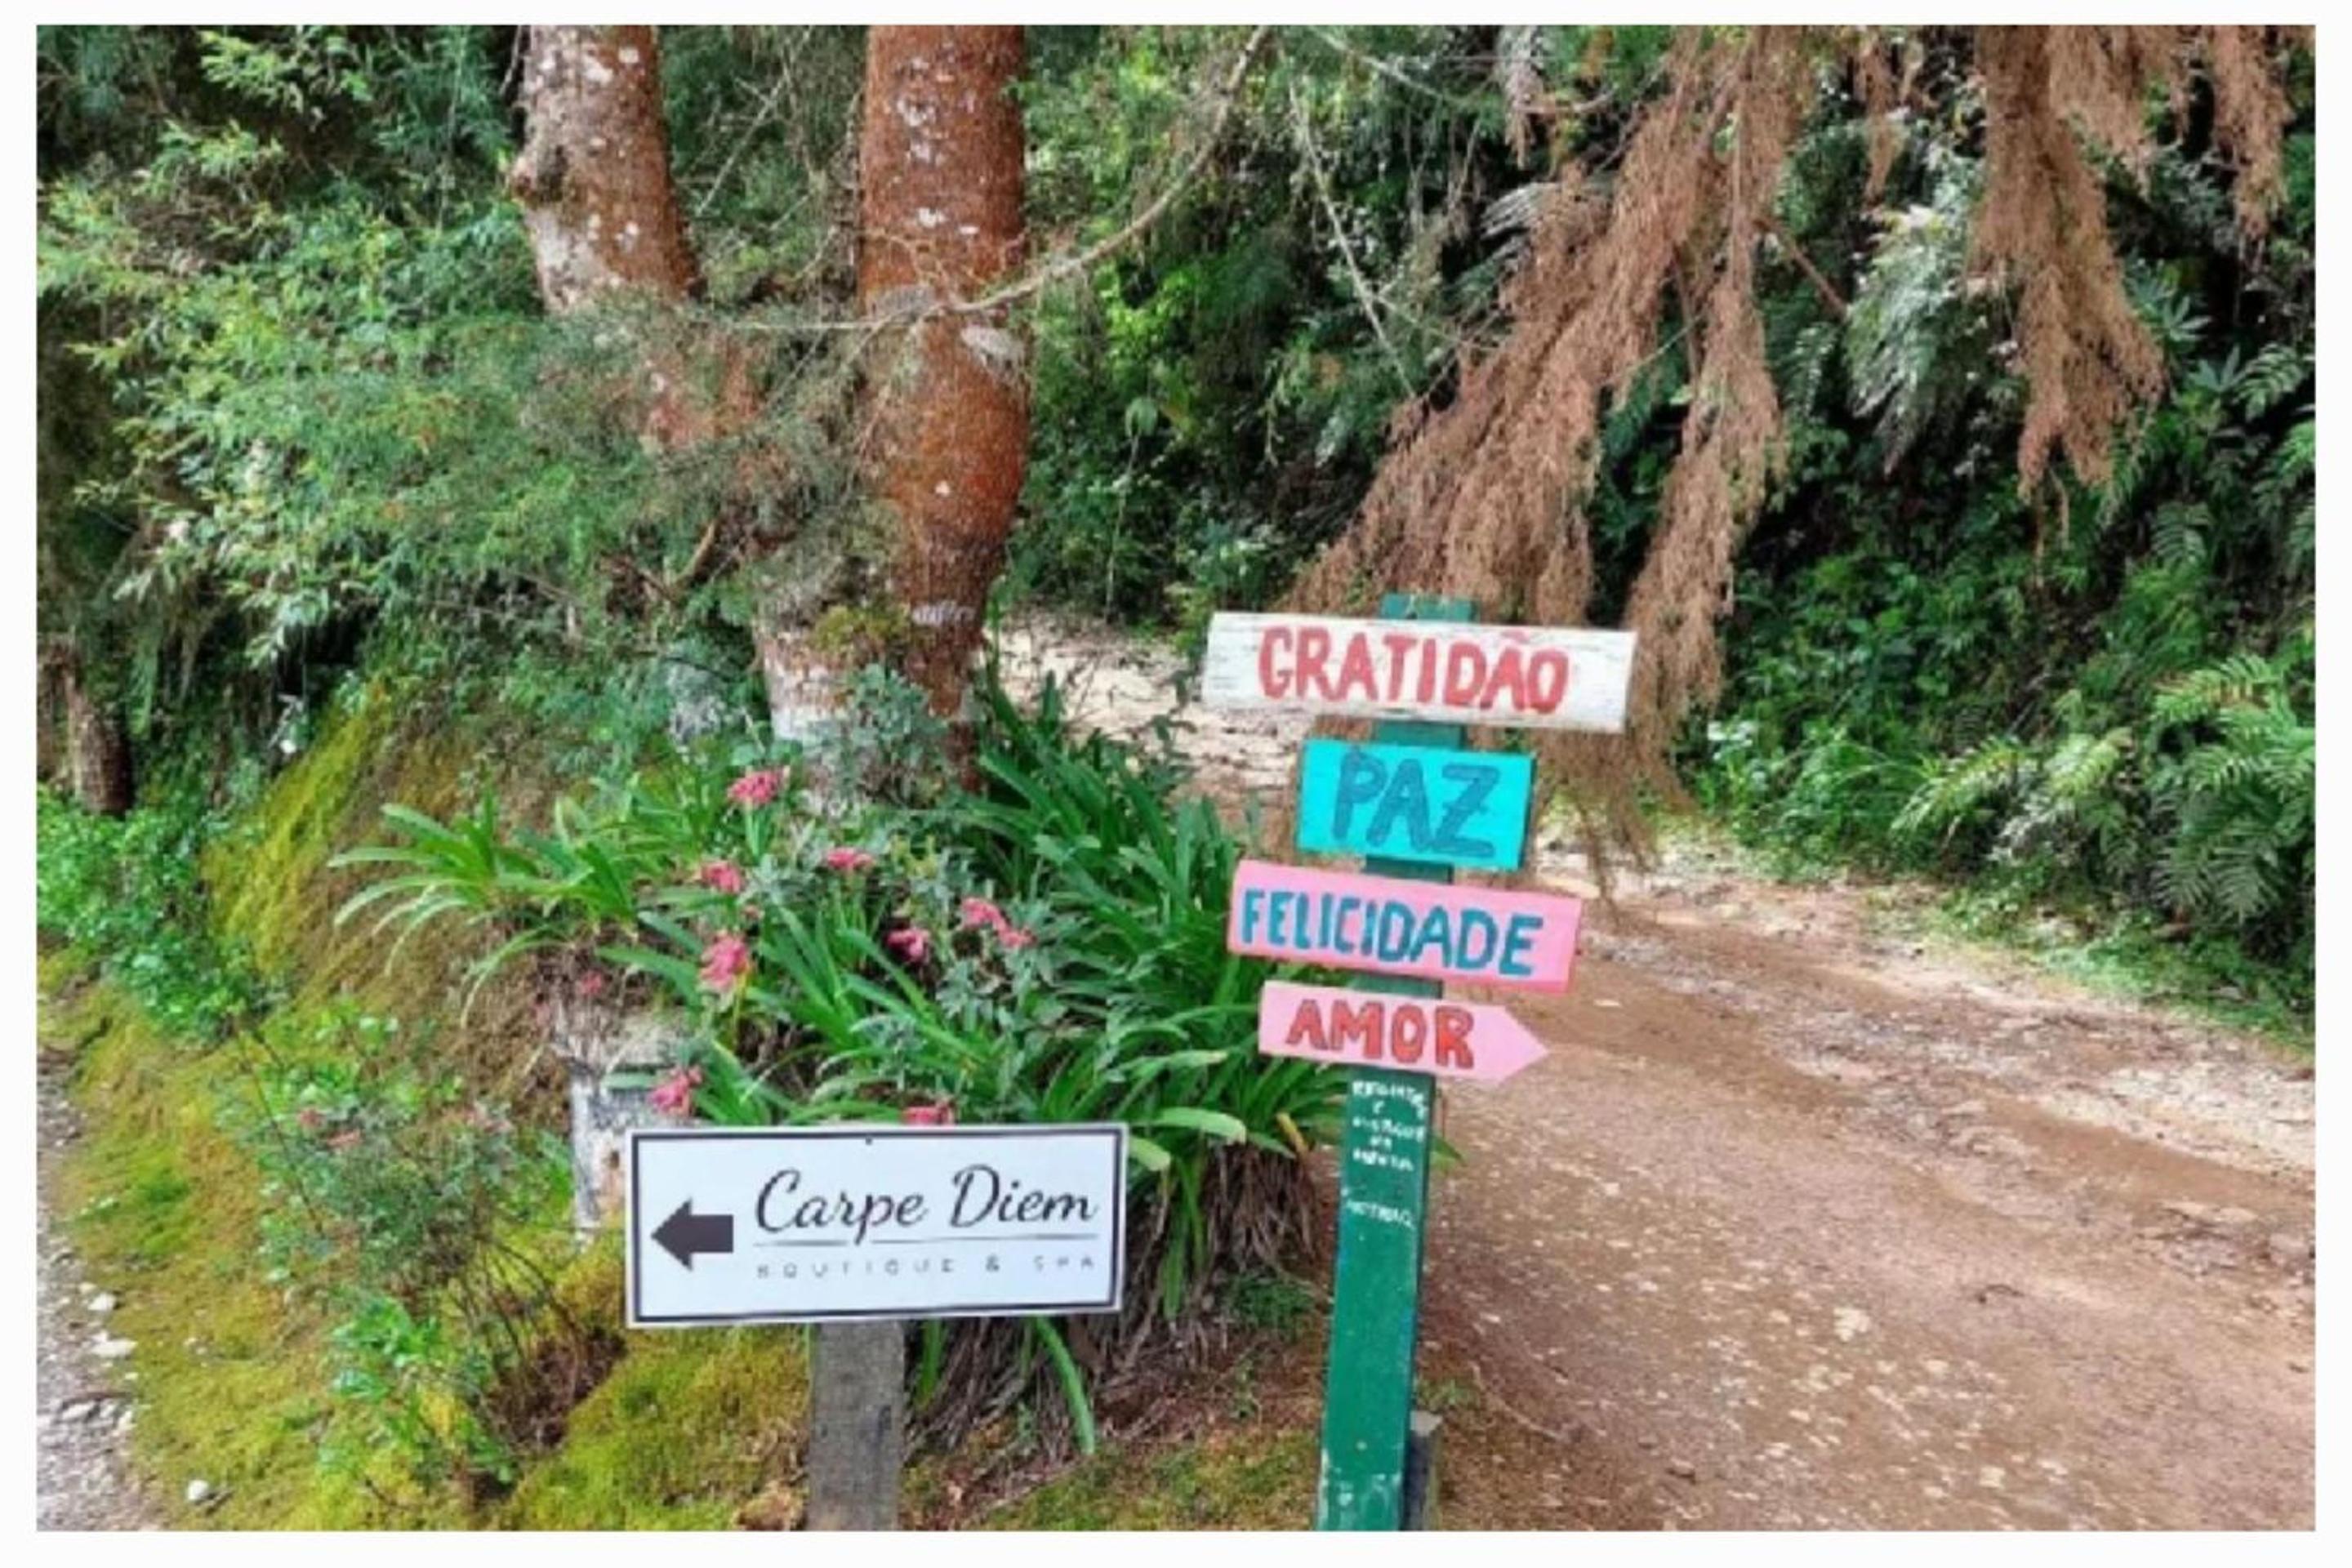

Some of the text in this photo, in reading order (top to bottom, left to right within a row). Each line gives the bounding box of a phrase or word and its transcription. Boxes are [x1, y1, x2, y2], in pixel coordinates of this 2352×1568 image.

[1258, 626, 1570, 715] GRATIDÃO
[1332, 745, 1500, 859] PAZ
[1240, 888, 1544, 976] FELICIDADE
[1285, 998, 1475, 1069] AMOR
[755, 1163, 1098, 1246] Carpe Diem
